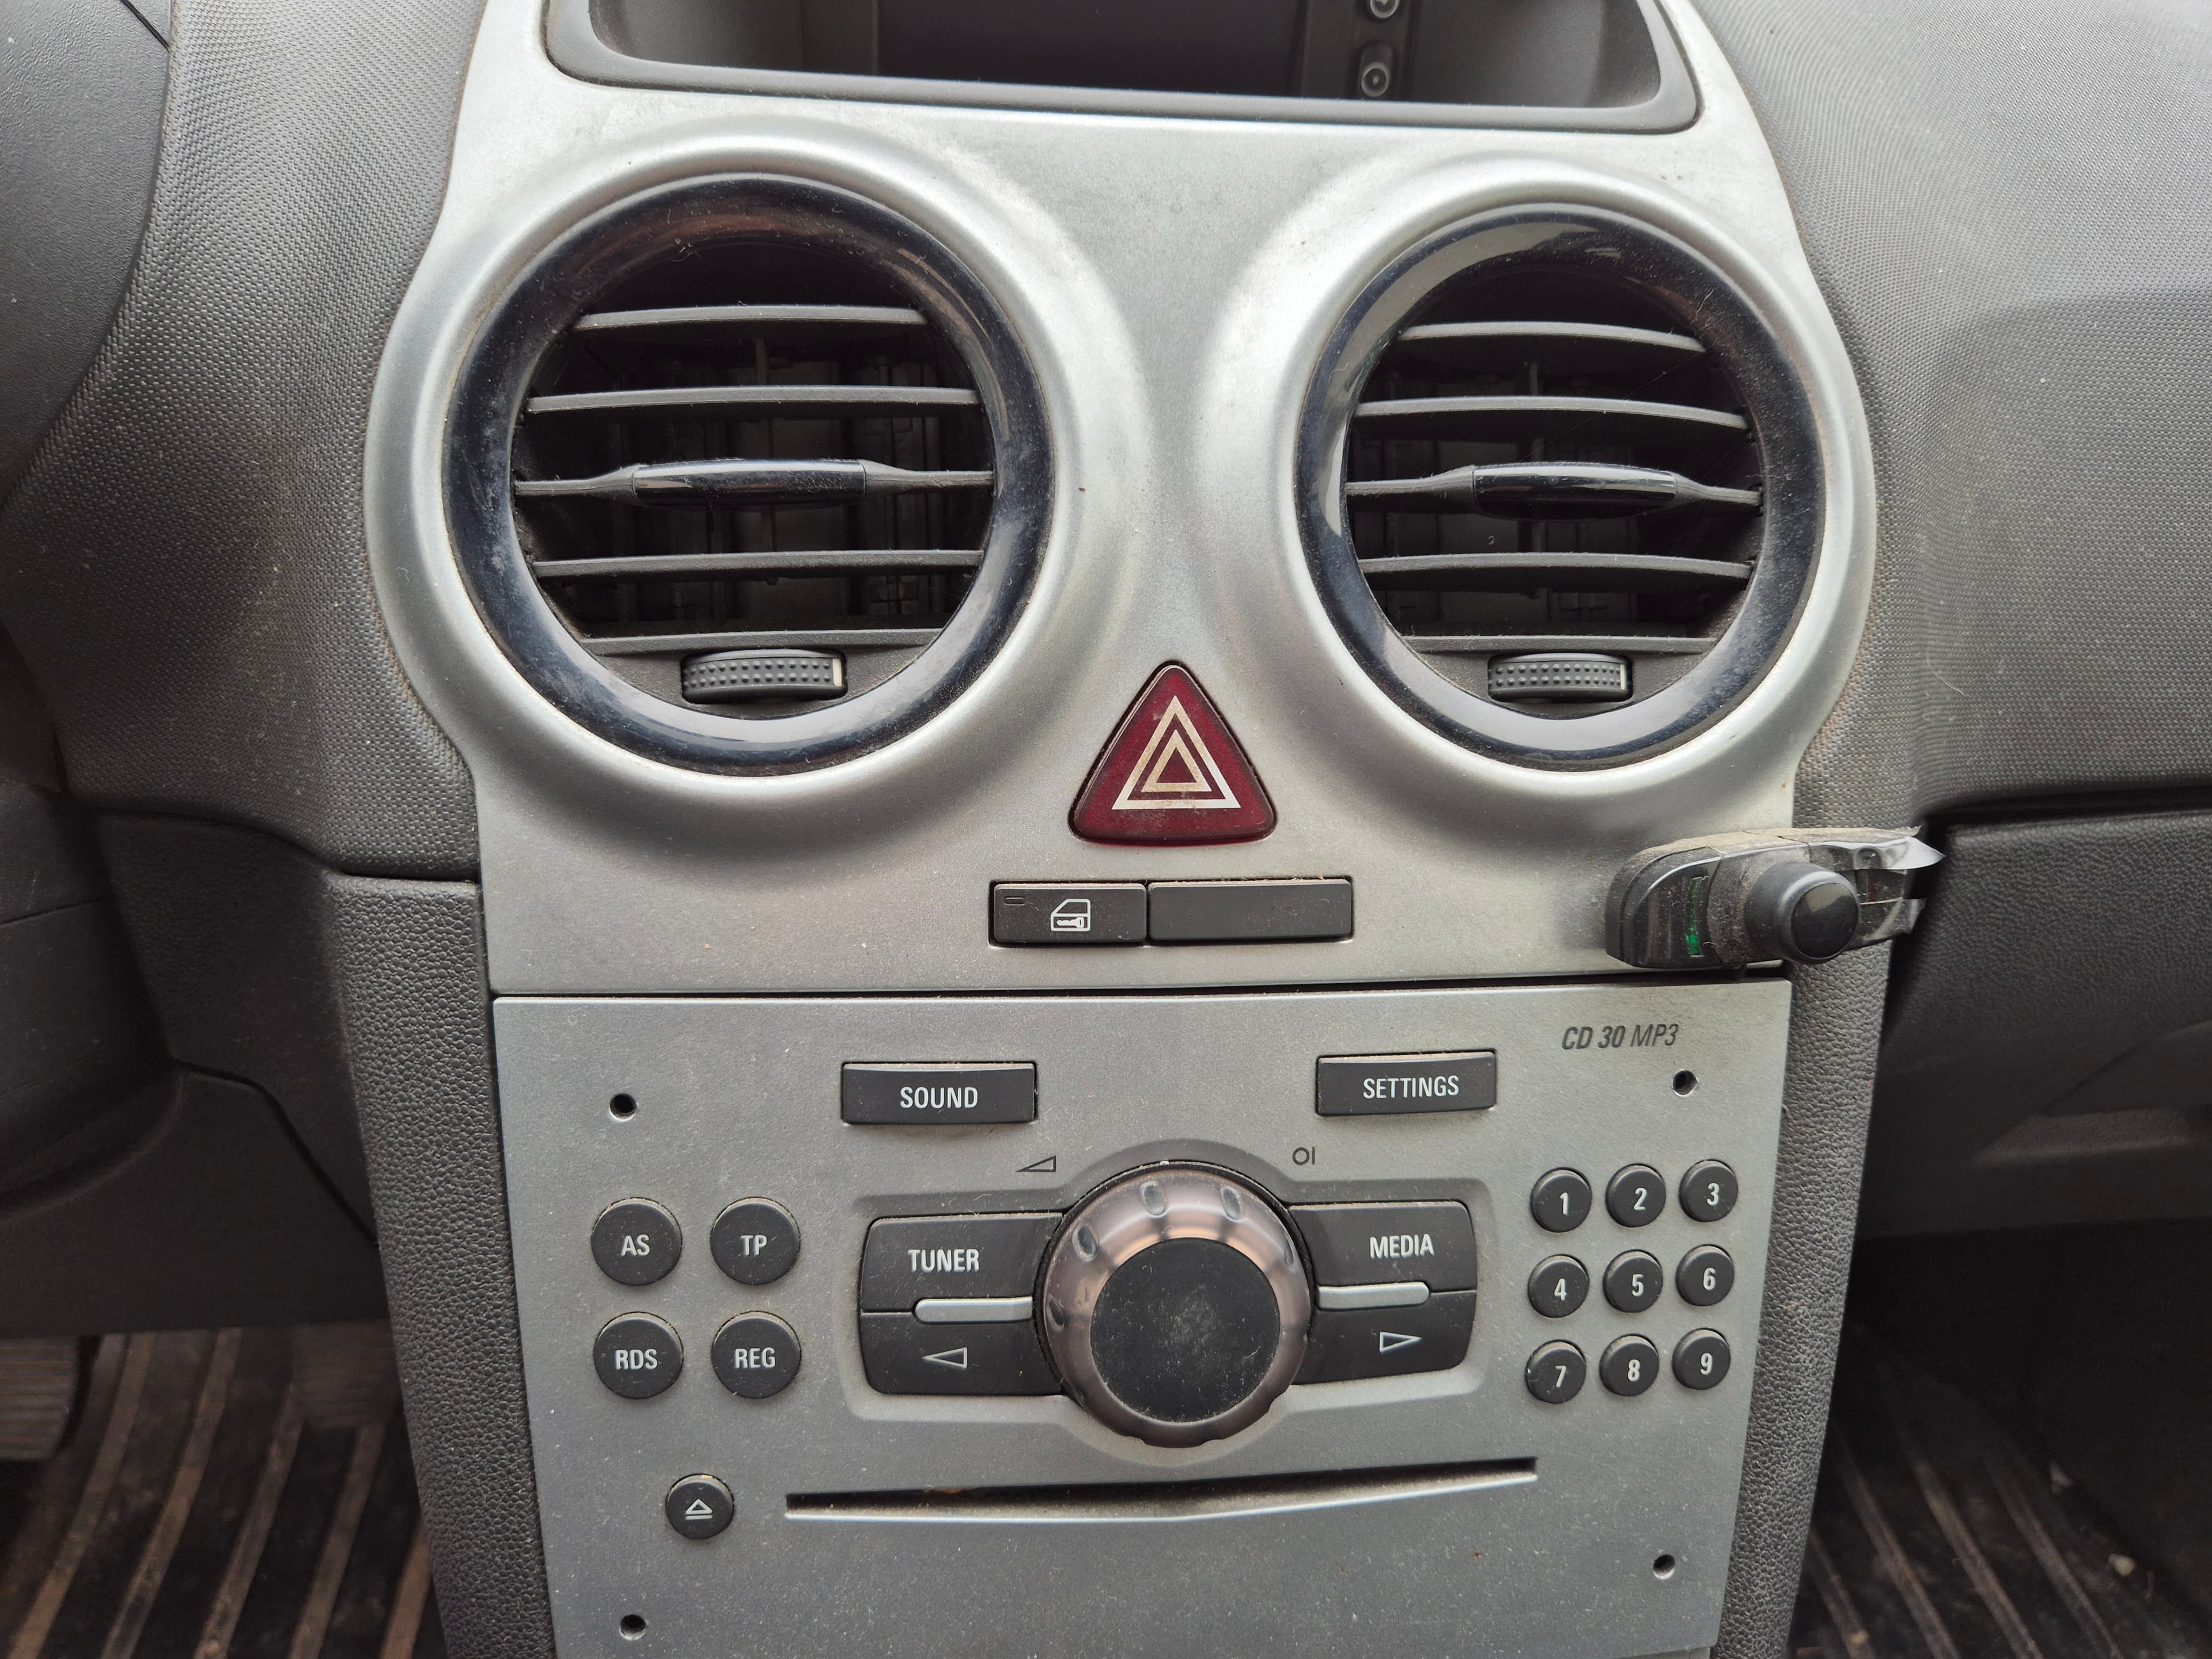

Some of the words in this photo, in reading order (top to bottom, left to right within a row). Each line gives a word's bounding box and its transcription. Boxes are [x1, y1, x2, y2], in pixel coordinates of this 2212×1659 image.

[1562, 1026, 1593, 1050] CD
[1597, 1025, 1626, 1049] 30
[1630, 1023, 1679, 1047] MP3
[900, 1086, 978, 1109] SOUND
[1363, 1075, 1459, 1099] SETTINGS
[1560, 1192, 1569, 1215] 1
[1634, 1187, 1647, 1210] 2
[1707, 1183, 1719, 1206] 3
[621, 1234, 650, 1256] AS
[740, 1234, 767, 1256] TP
[1370, 1233, 1434, 1259] MEDIA
[907, 1249, 979, 1272] TUNER
[1554, 1278, 1567, 1301] 4
[1632, 1274, 1644, 1297] 5
[1703, 1267, 1715, 1290] 6
[615, 1349, 658, 1370] RDS
[734, 1347, 775, 1369] REG
[1700, 1353, 1713, 1375] 9
[1555, 1365, 1567, 1388] 7
[1627, 1359, 1641, 1381] 8
